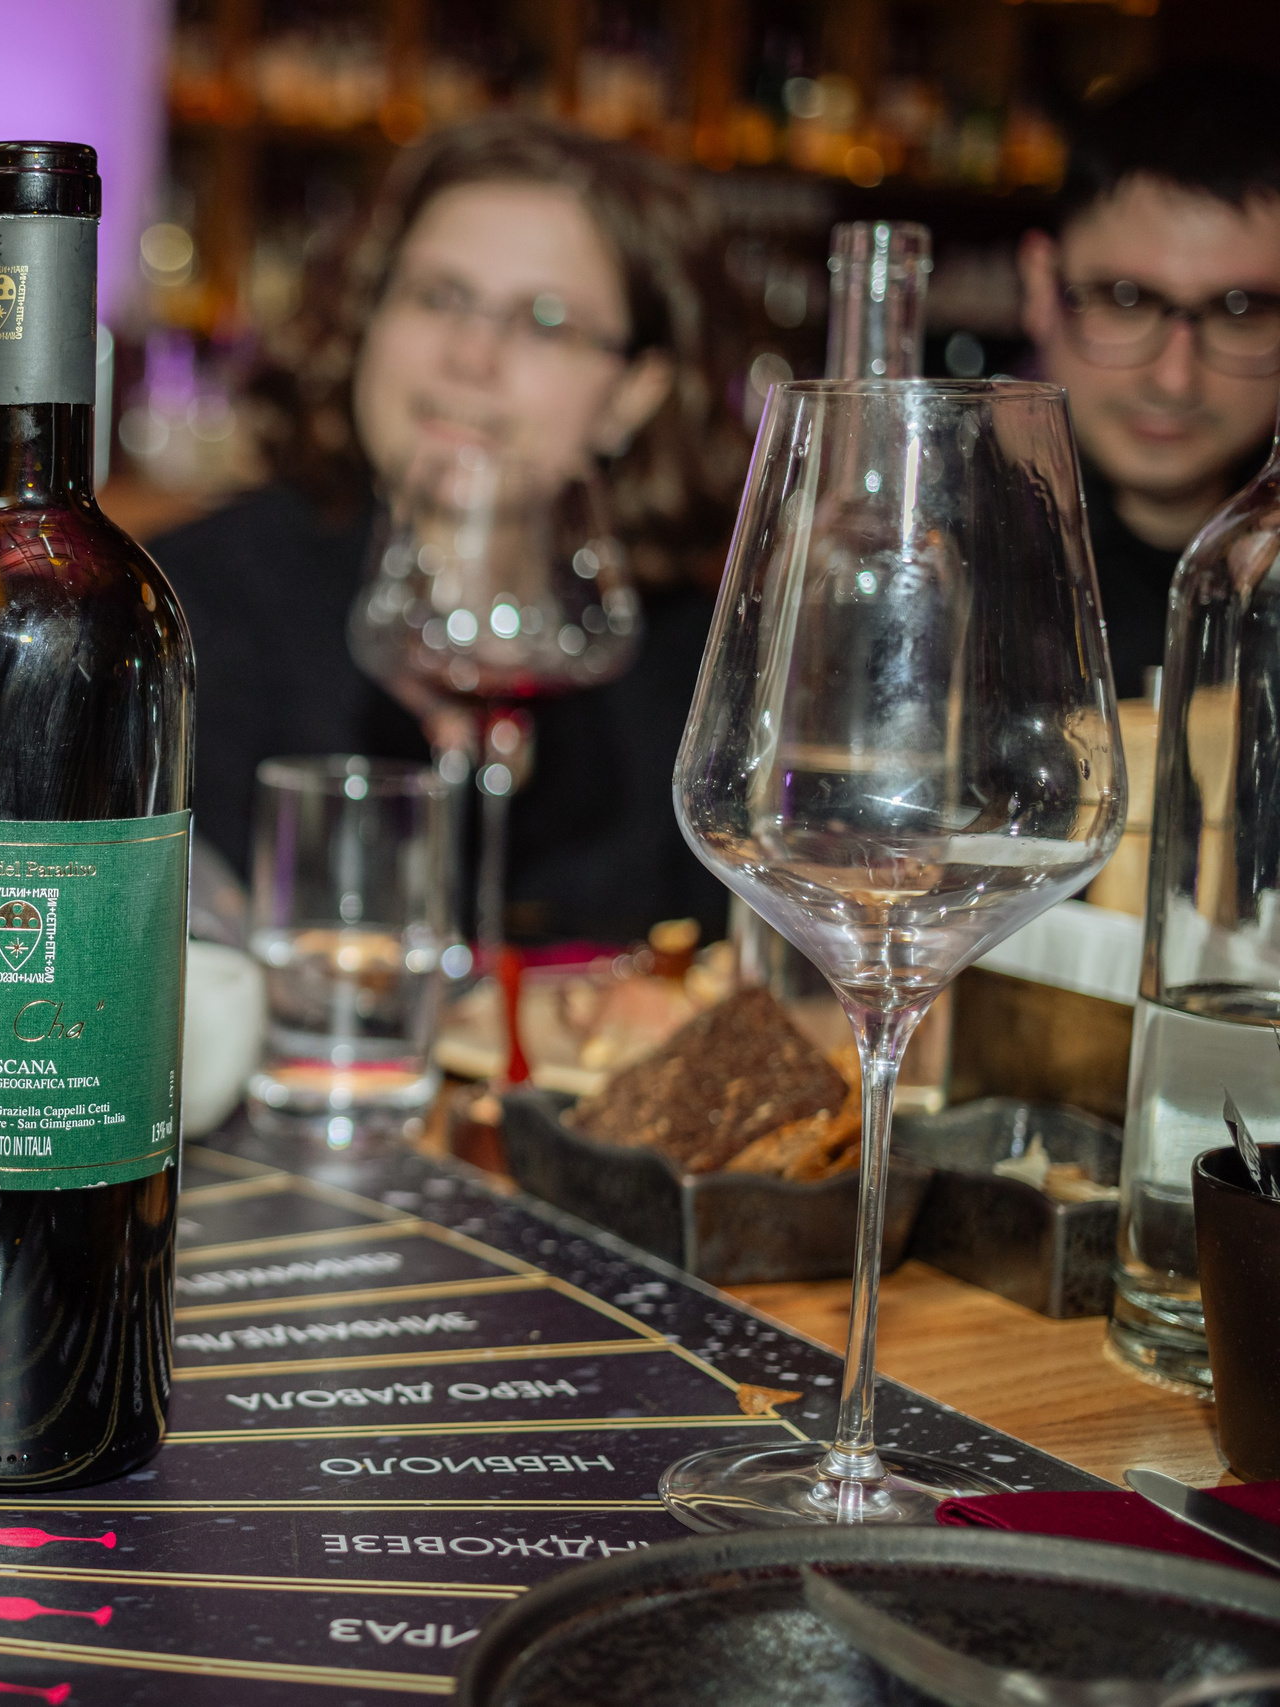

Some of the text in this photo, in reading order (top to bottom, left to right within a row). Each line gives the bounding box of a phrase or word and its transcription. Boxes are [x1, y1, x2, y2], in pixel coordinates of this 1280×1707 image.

[26, 861, 97, 878] Paradiso
[67, 1076, 100, 1087] TIPICA
[43, 1104, 85, 1119] Cappelli
[87, 1102, 110, 1114] Cetti
[18, 1117, 37, 1129] San
[40, 1116, 95, 1131] Gimignano
[103, 1113, 125, 1124] Italia
[151, 1120, 166, 1143] 13%
[13, 1136, 22, 1156] IN
[24, 1134, 52, 1156] ITALIA
[176, 1311, 478, 1353] ЗИНФАНДЕЛЬ
[448, 1378, 578, 1402] НЕРО
[320, 1454, 615, 1476] НЕББИОЛО
[321, 1533, 651, 1558] НДЖОВЕЗЕ
